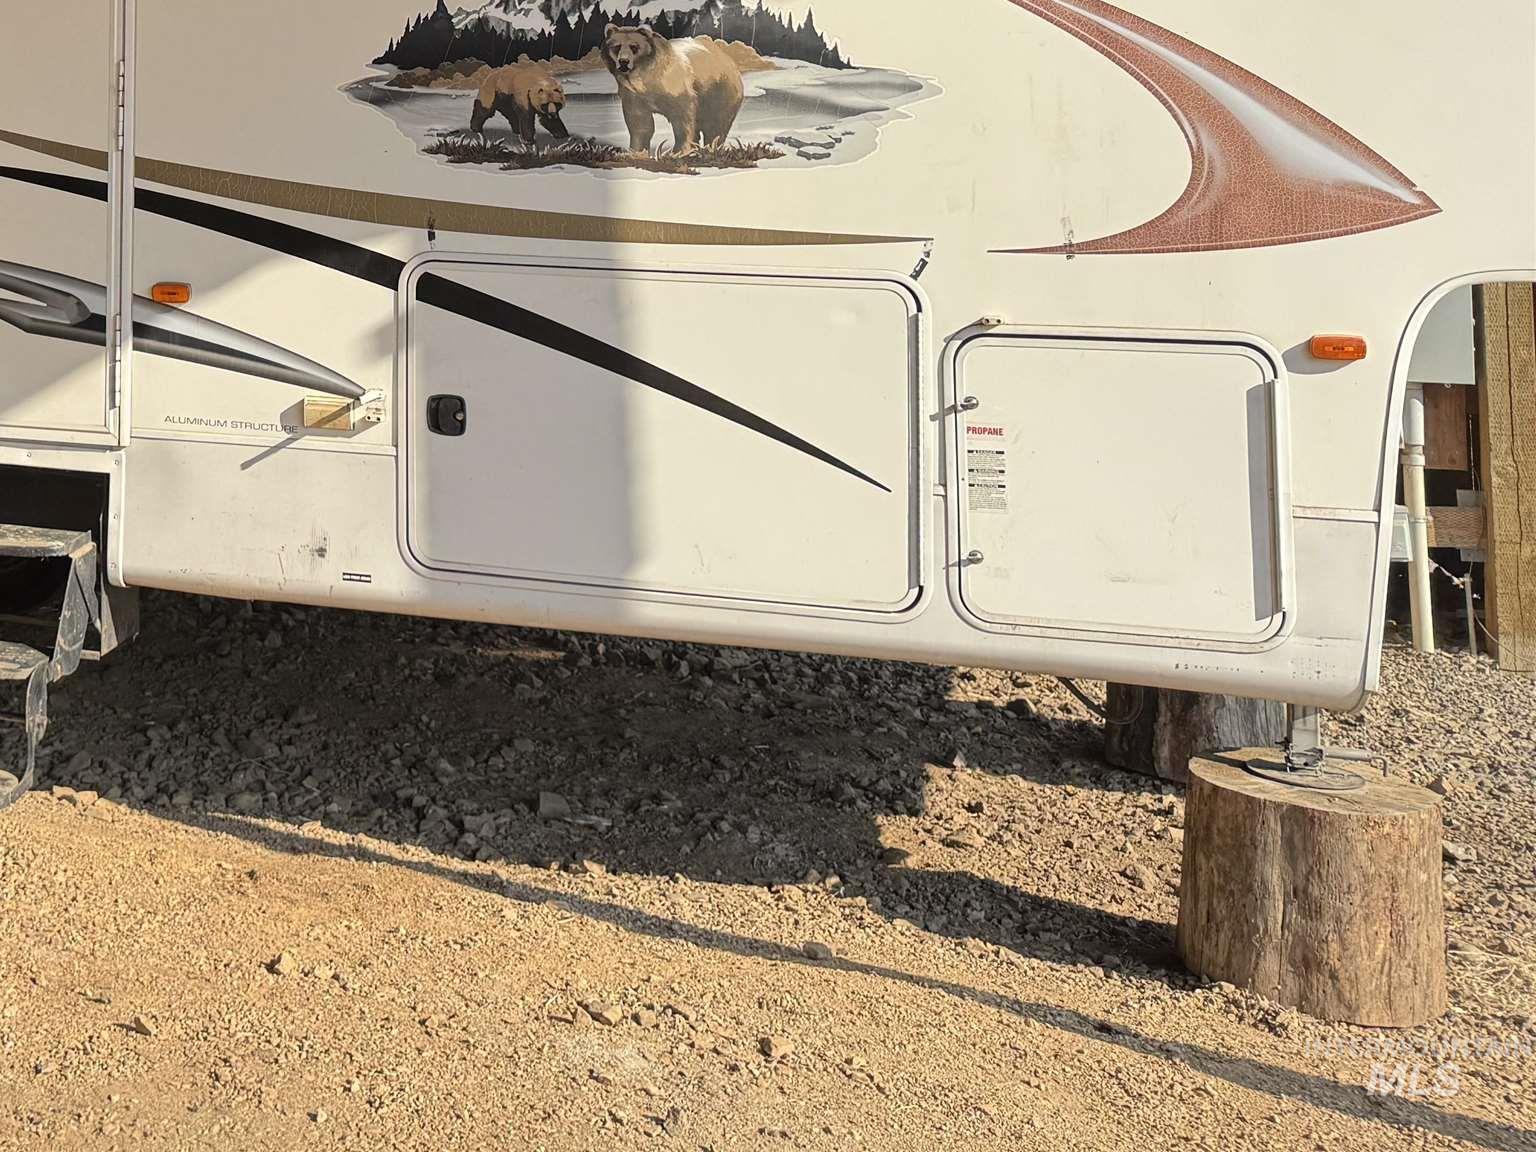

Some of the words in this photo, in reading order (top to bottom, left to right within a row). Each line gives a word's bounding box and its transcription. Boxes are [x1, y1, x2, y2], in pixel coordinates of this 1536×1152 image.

[163, 414, 228, 428] ALUMINUM
[230, 420, 299, 434] STRUCTURE
[966, 426, 1004, 436] PROPANE
